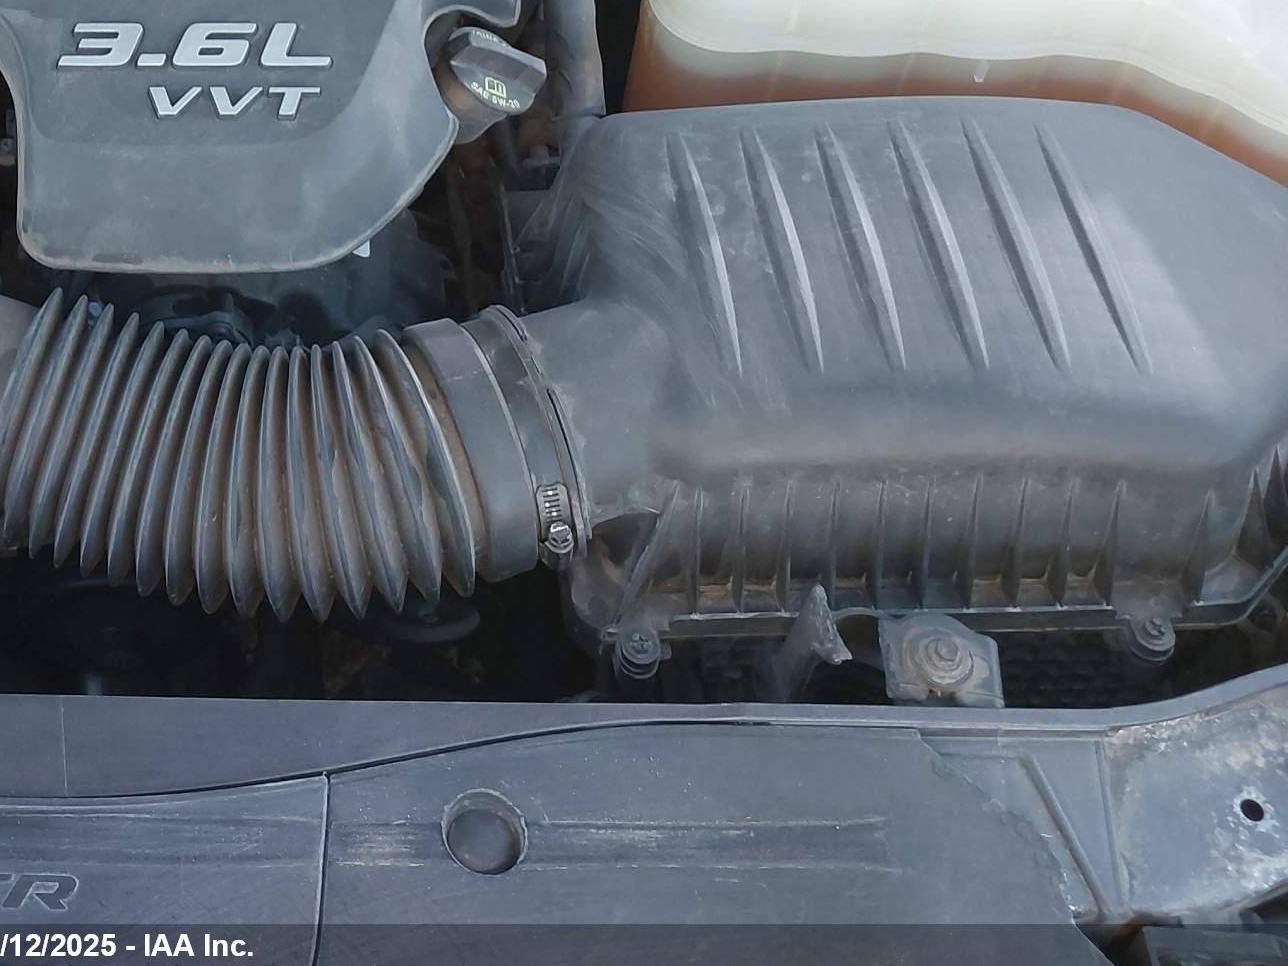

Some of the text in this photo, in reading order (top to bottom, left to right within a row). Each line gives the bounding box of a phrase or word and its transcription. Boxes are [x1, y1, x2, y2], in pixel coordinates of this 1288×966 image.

[58, 22, 333, 67] 3.6L
[148, 86, 322, 119] VVT
[470, 80, 521, 109] SAE 5W-20
